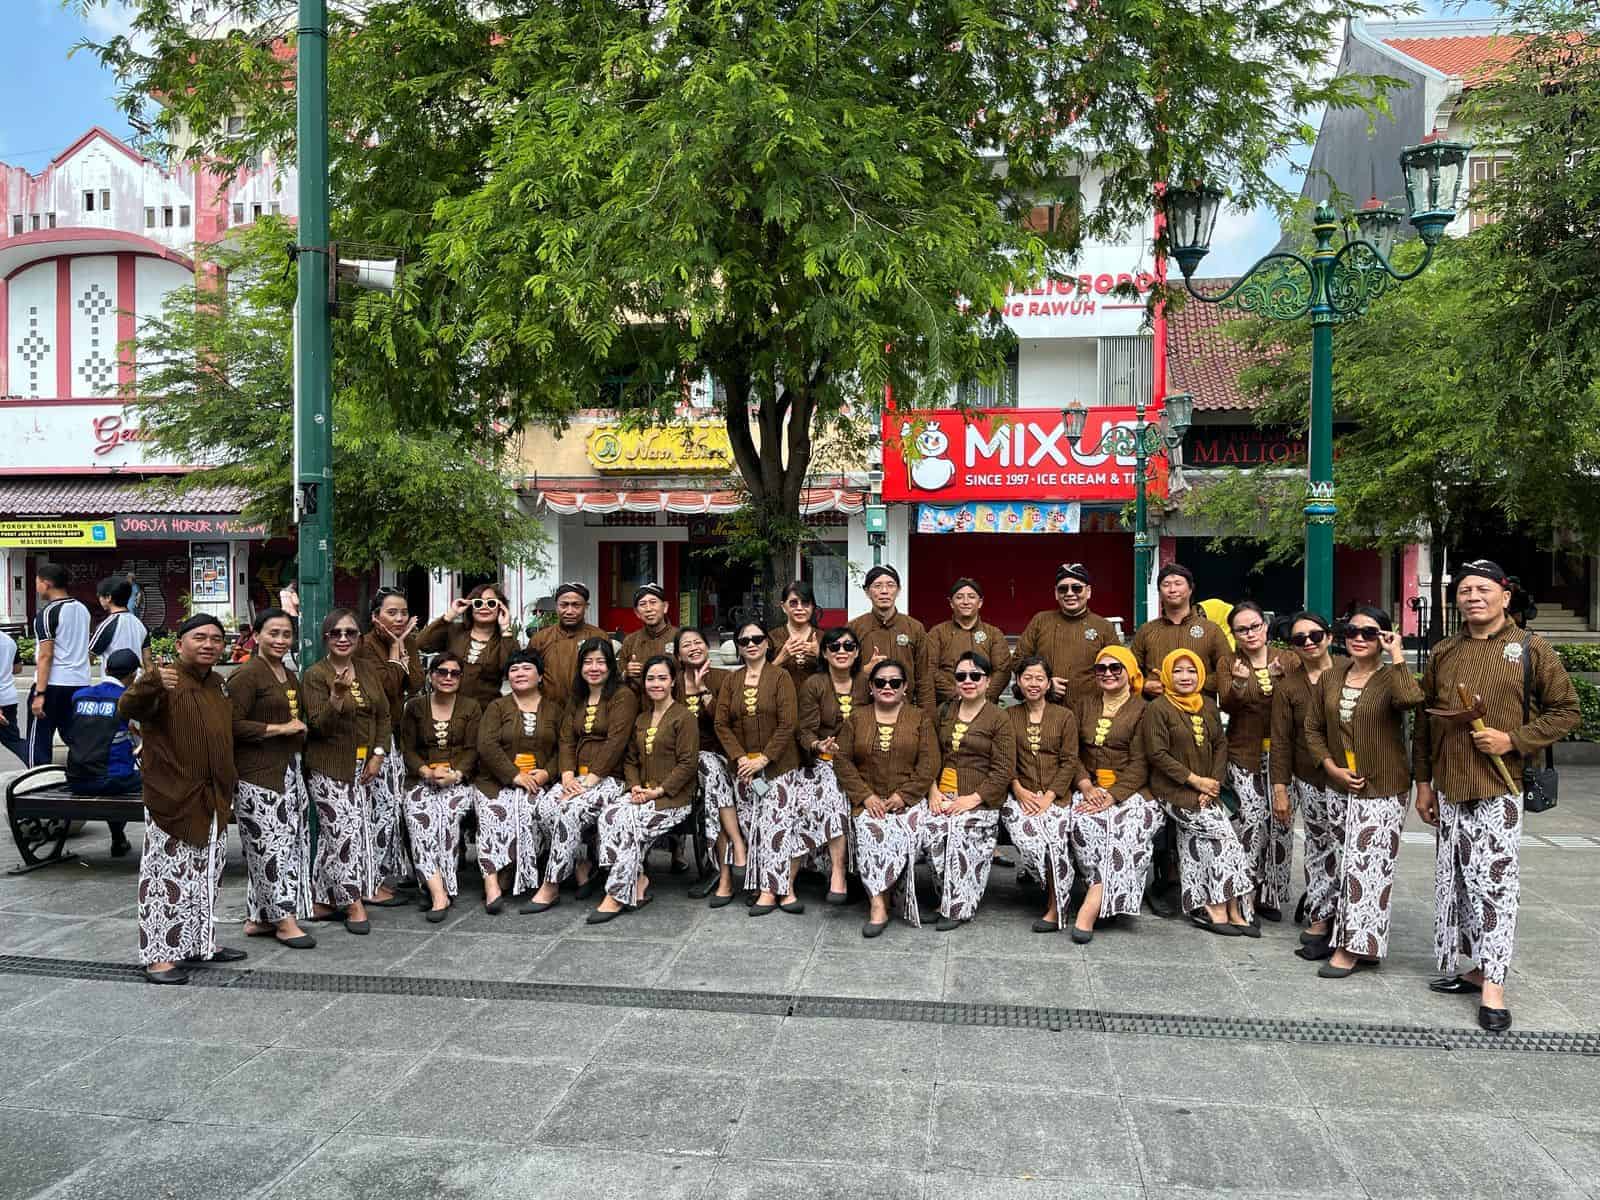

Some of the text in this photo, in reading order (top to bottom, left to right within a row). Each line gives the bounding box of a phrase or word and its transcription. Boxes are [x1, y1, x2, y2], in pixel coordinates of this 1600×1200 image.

[1029, 301, 1096, 316] RAWUH
[965, 473, 1002, 486] SINCE
[1006, 473, 1029, 485] 1997
[1037, 473, 1057, 485] ICE
[1060, 473, 1106, 485] CREAM
[1110, 473, 1121, 485] &
[172, 518, 212, 533] HOROR
